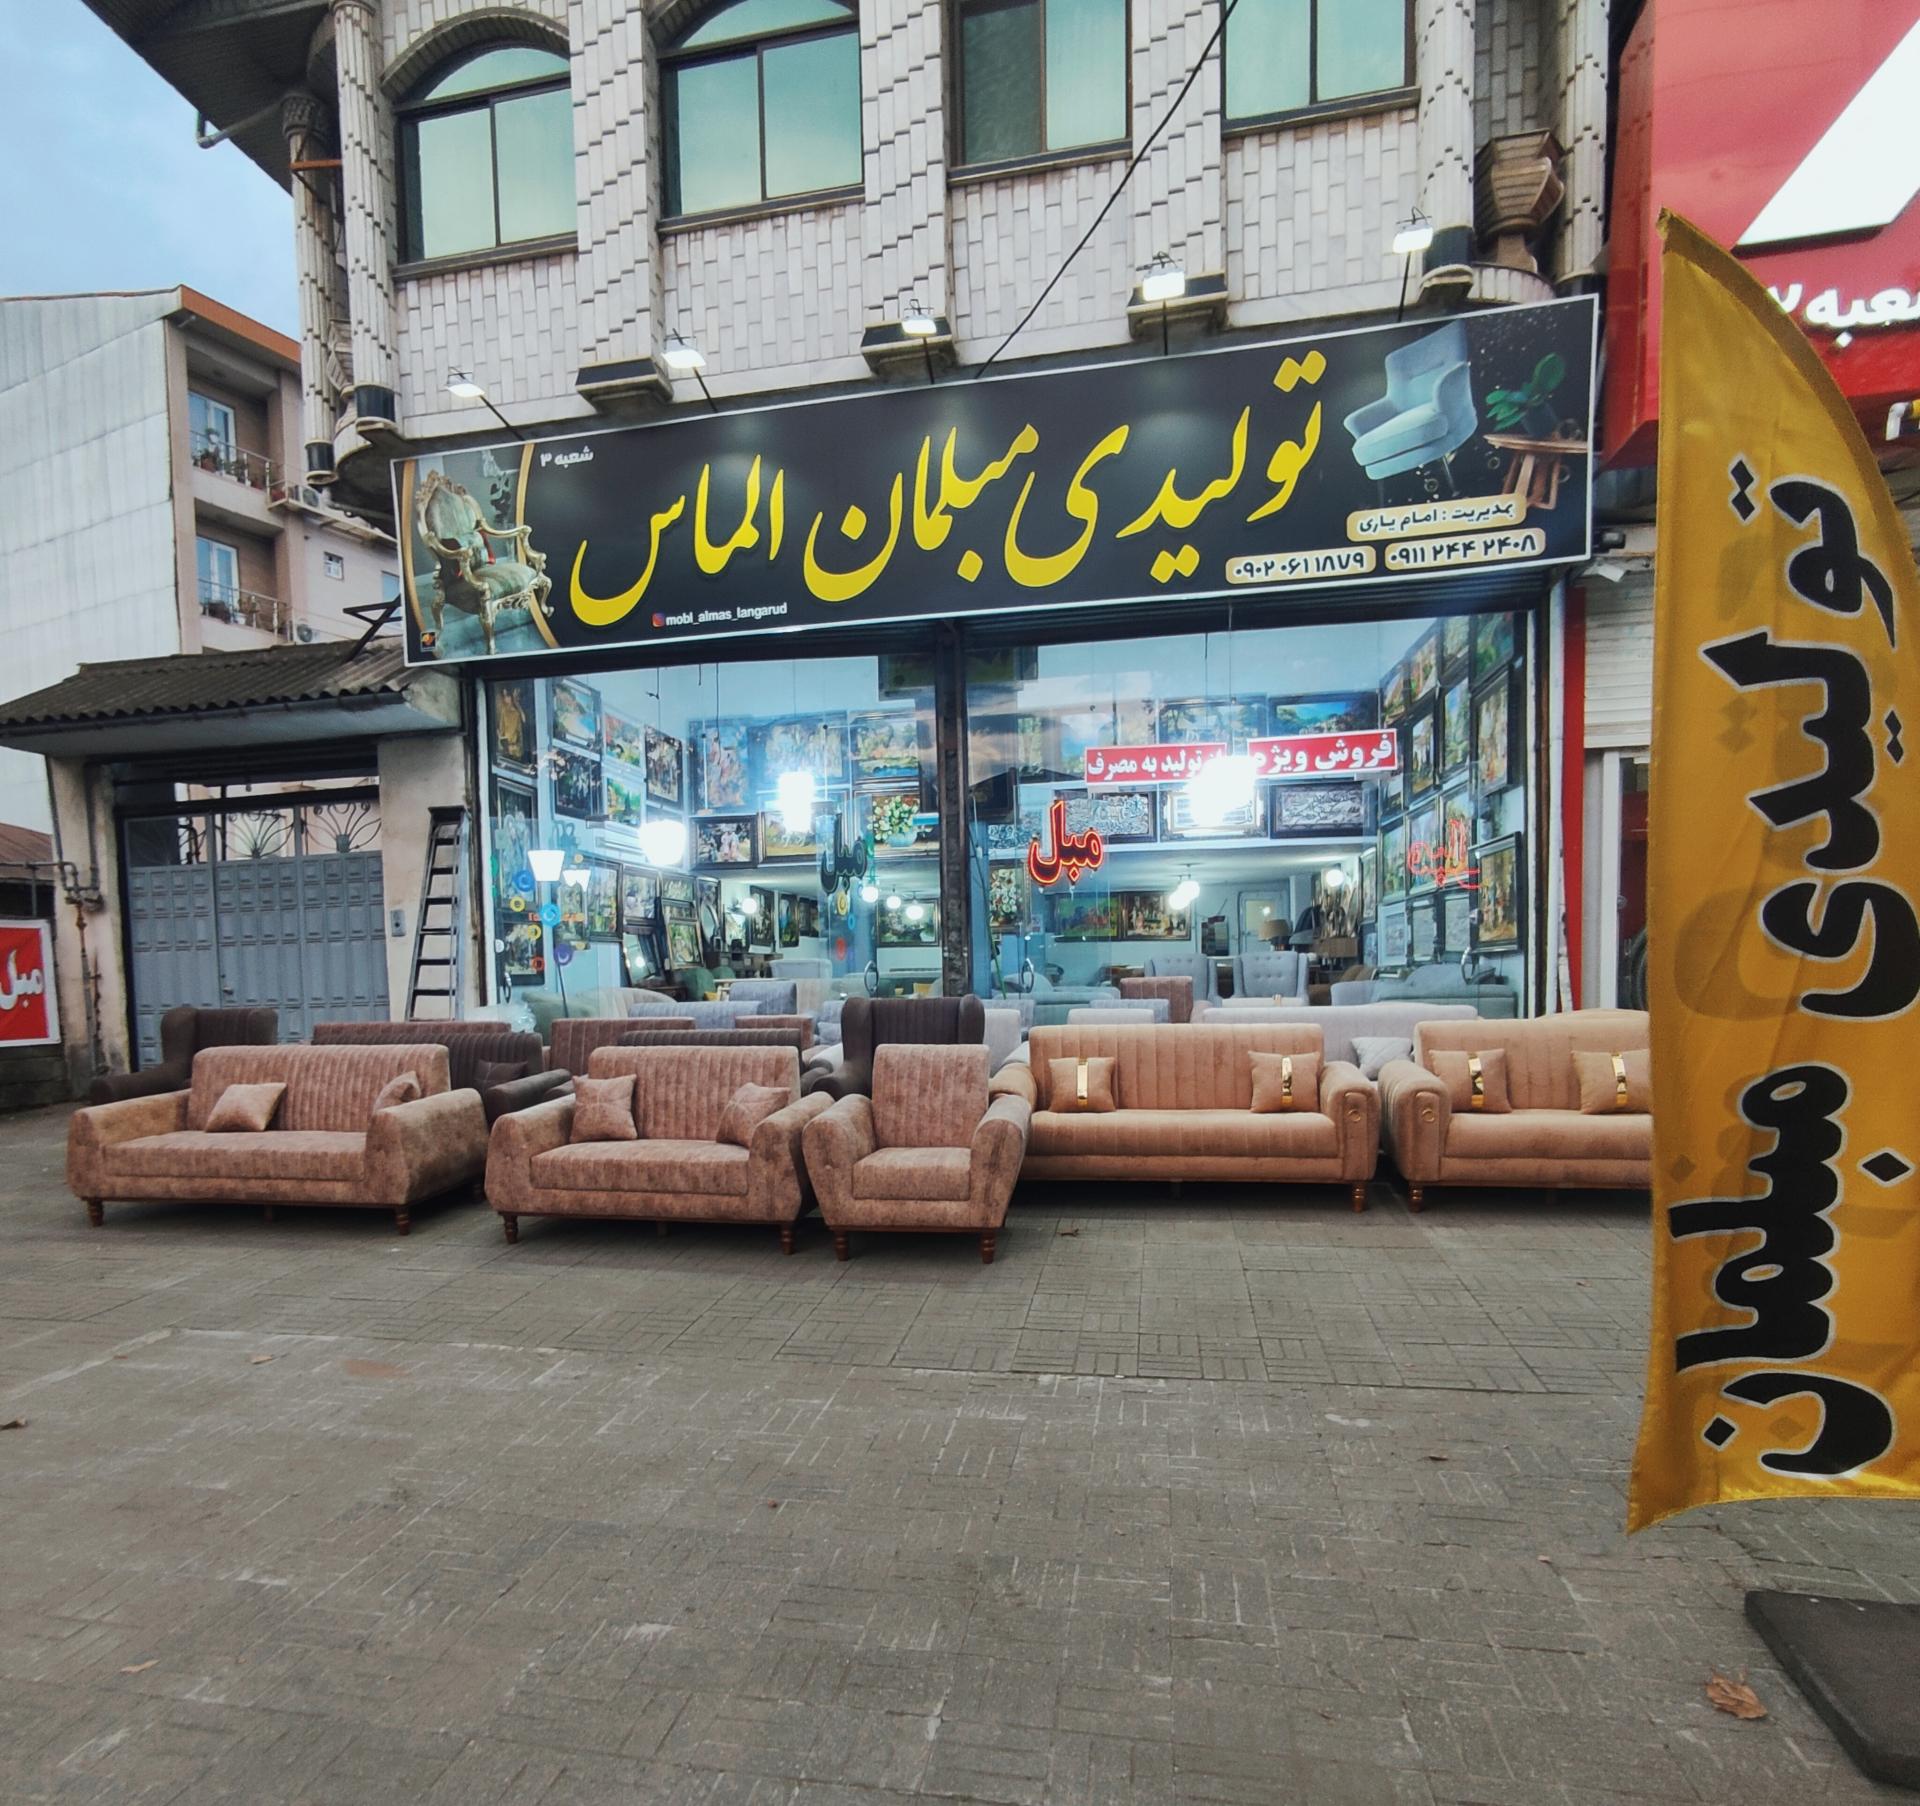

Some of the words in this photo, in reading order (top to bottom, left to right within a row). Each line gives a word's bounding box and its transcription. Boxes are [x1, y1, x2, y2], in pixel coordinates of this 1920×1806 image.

[1805, 284, 1920, 347] عبه
[554, 445, 594, 469] شعبه
[1005, 350, 1327, 586] تولیدی
[570, 455, 784, 627] الماس
[804, 423, 1040, 602] مبلمان
[1359, 514, 1396, 533] یاری
[1400, 509, 1437, 532] امام
[1087, 752, 1138, 781] مصرف
[1142, 755, 1157, 778] به
[1160, 749, 1203, 777] تولید
[1253, 744, 1308, 774] ویژه
[1315, 733, 1393, 770] فروش
[1698, 458, 1920, 1022] تولیدی
[820, 812, 868, 895] مبل
[1028, 799, 1104, 886] مبل
[0, 949, 45, 1011] مبل
[1668, 1062, 1914, 1479] مبلمان
